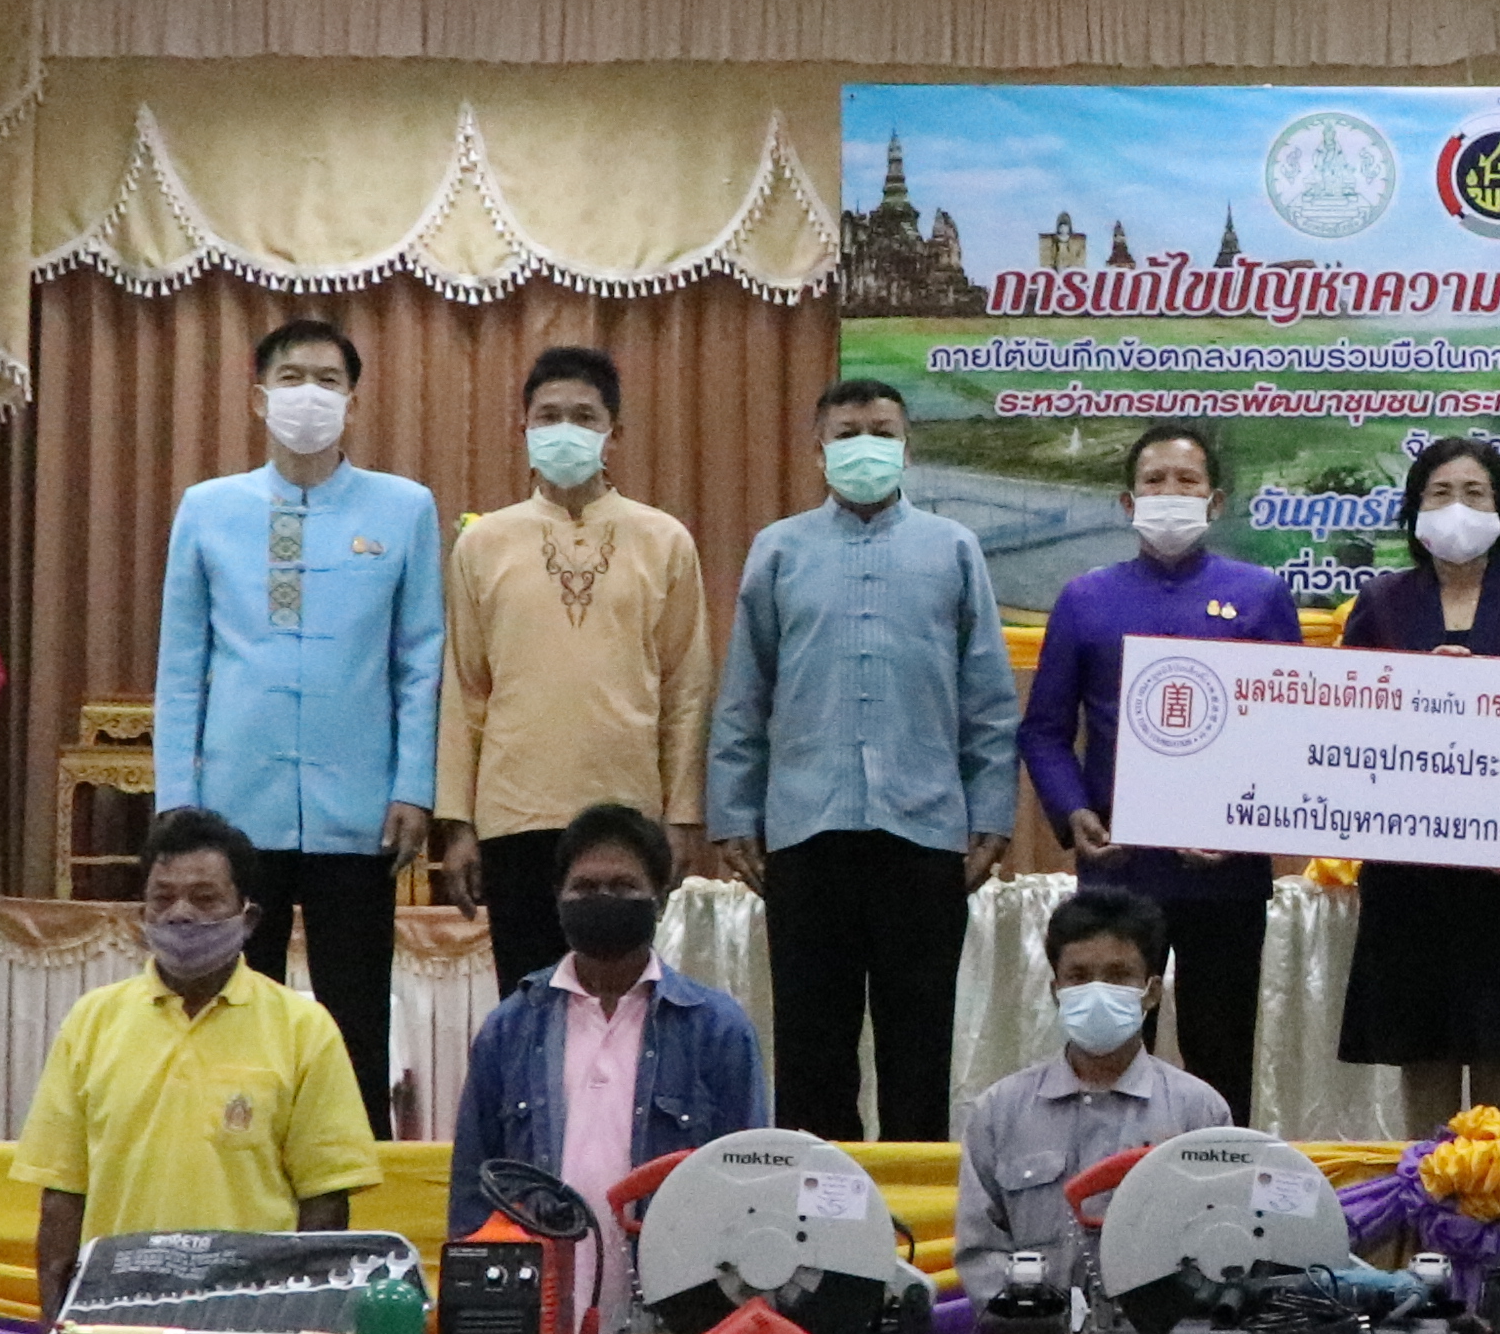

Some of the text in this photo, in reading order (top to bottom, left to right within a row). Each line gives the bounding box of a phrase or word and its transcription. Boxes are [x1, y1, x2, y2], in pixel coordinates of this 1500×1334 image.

[1411, 690, 1466, 717] ร่วมกับ
[723, 1152, 795, 1166] maktec
[1181, 1150, 1254, 1164] maktec
